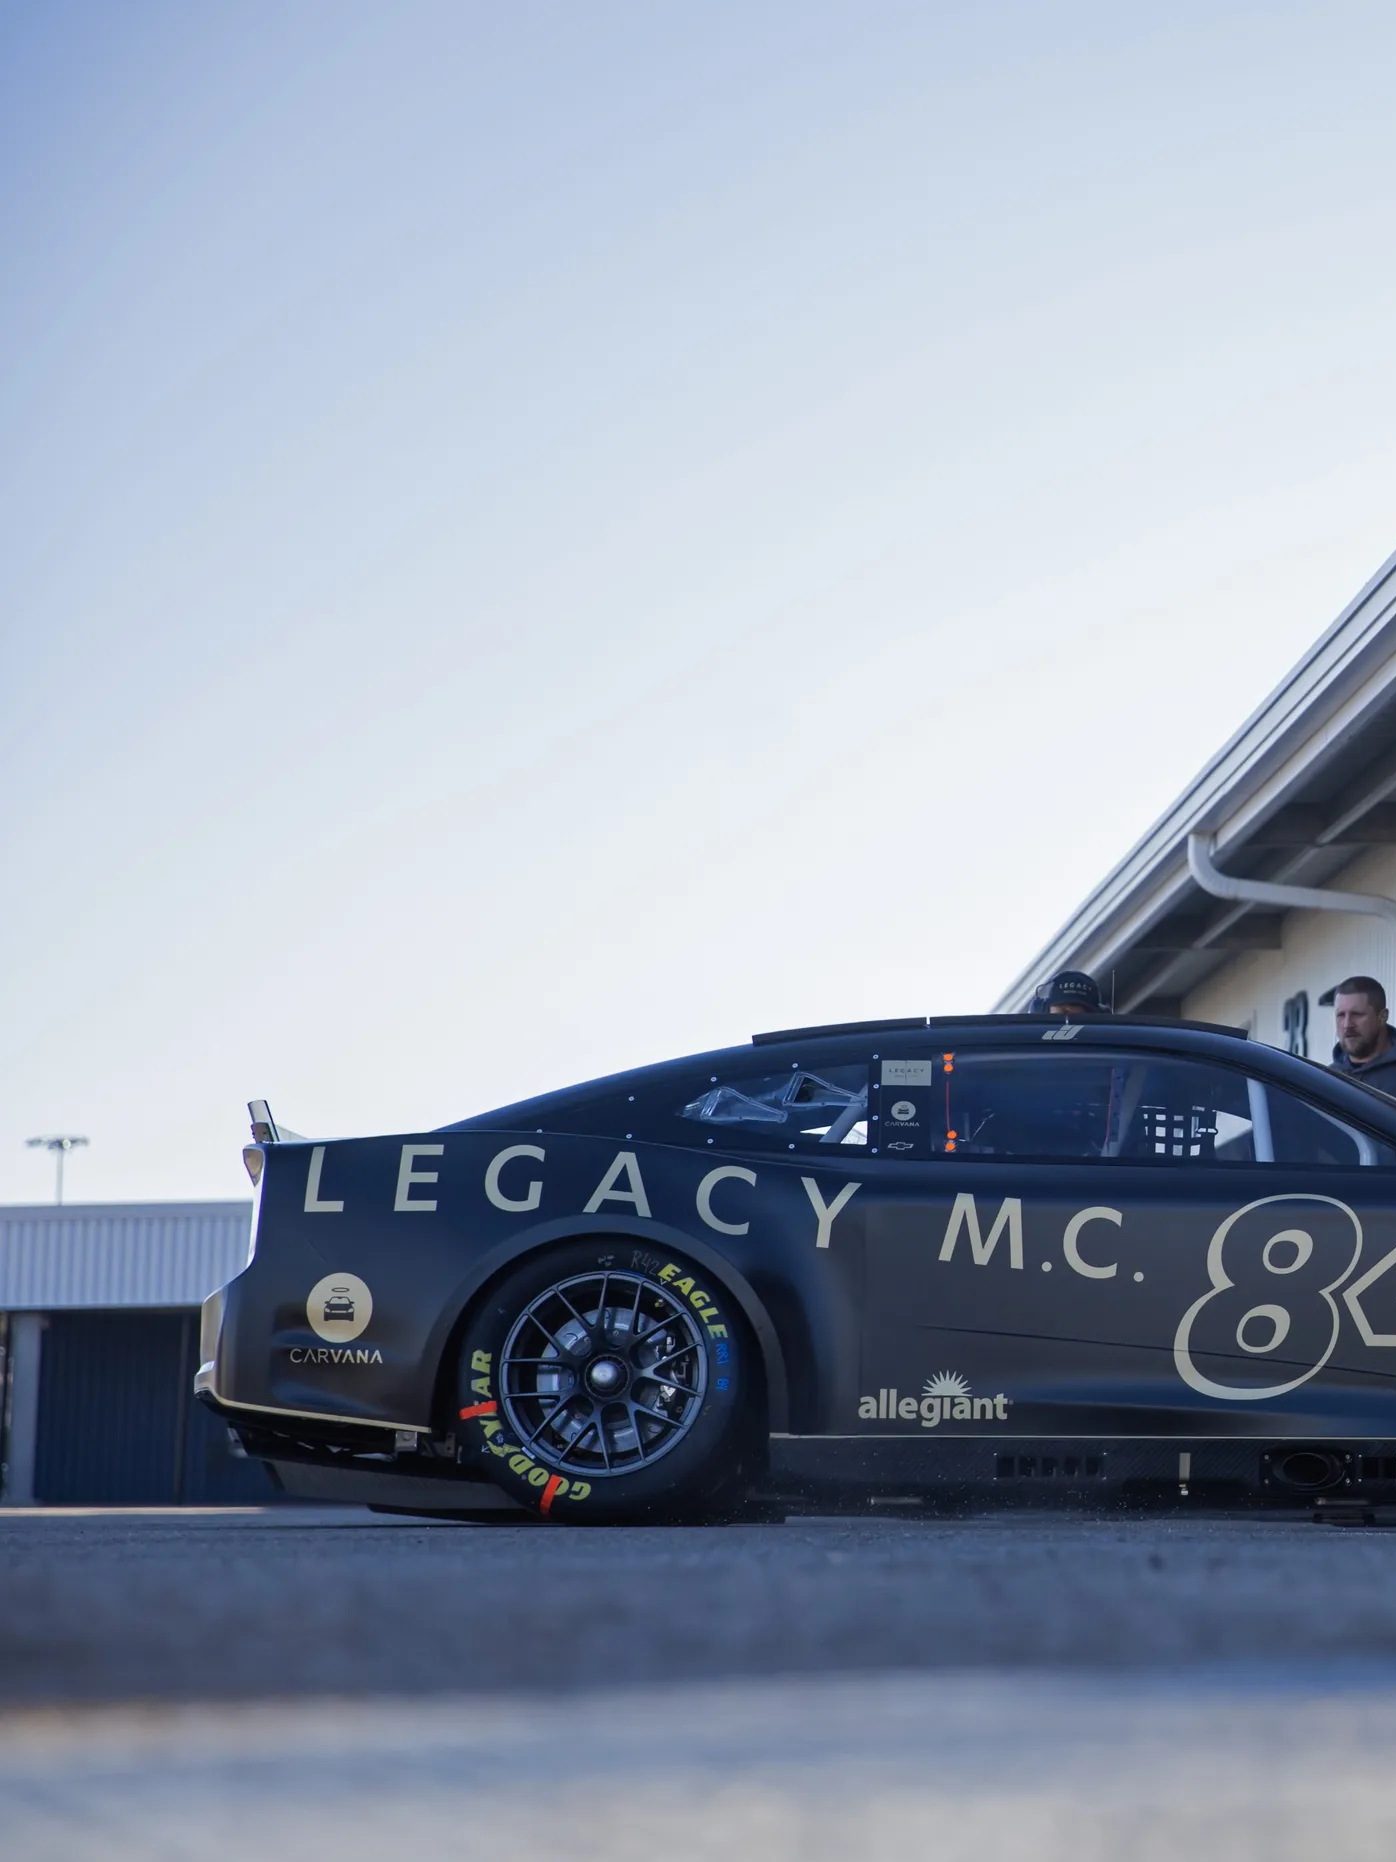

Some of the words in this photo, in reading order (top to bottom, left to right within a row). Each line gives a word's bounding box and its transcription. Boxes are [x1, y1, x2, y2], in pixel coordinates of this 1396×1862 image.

[303, 1144, 863, 1250] LEGACY
[938, 1191, 1145, 1283] M.C.
[657, 1262, 729, 1340] EAGLE
[289, 1347, 384, 1365] CARVANA
[857, 1388, 1009, 1428] allegiant
